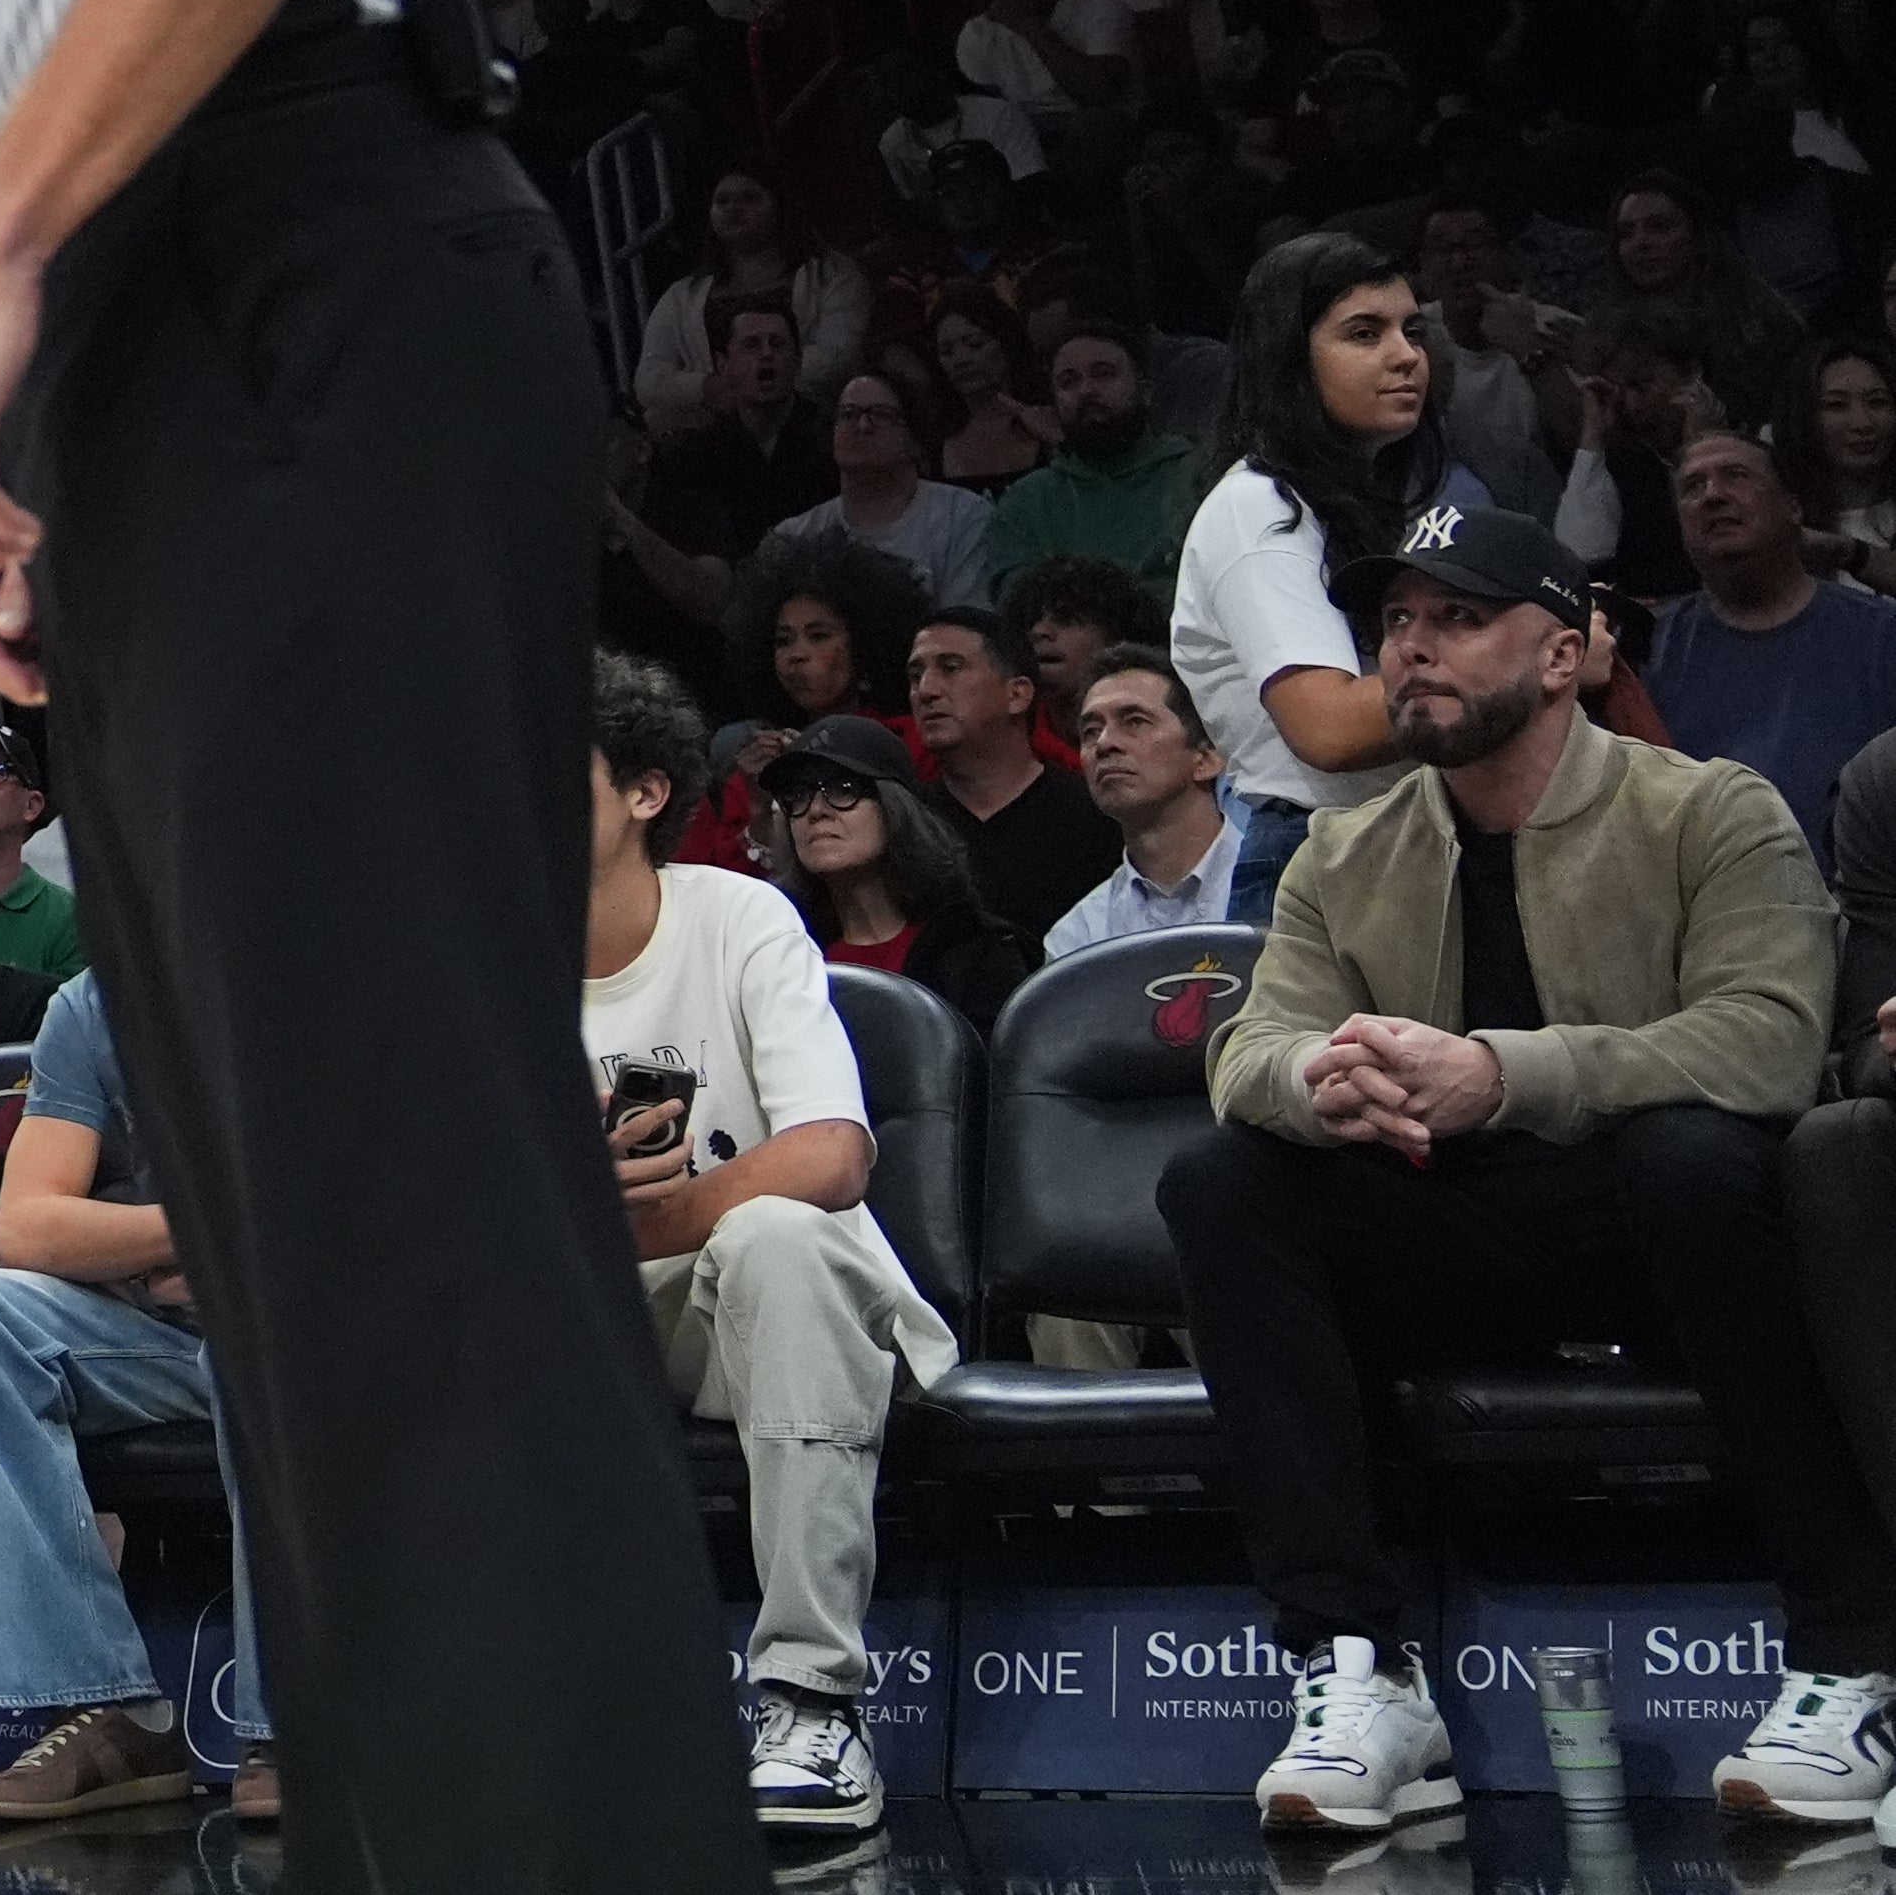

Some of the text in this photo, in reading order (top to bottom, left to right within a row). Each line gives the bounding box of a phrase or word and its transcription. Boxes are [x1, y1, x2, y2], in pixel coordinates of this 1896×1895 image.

[973, 1651, 1084, 1695] ONE
[1457, 1644, 1537, 1692] ON
[1145, 1700, 1300, 1719] INTERNATION
